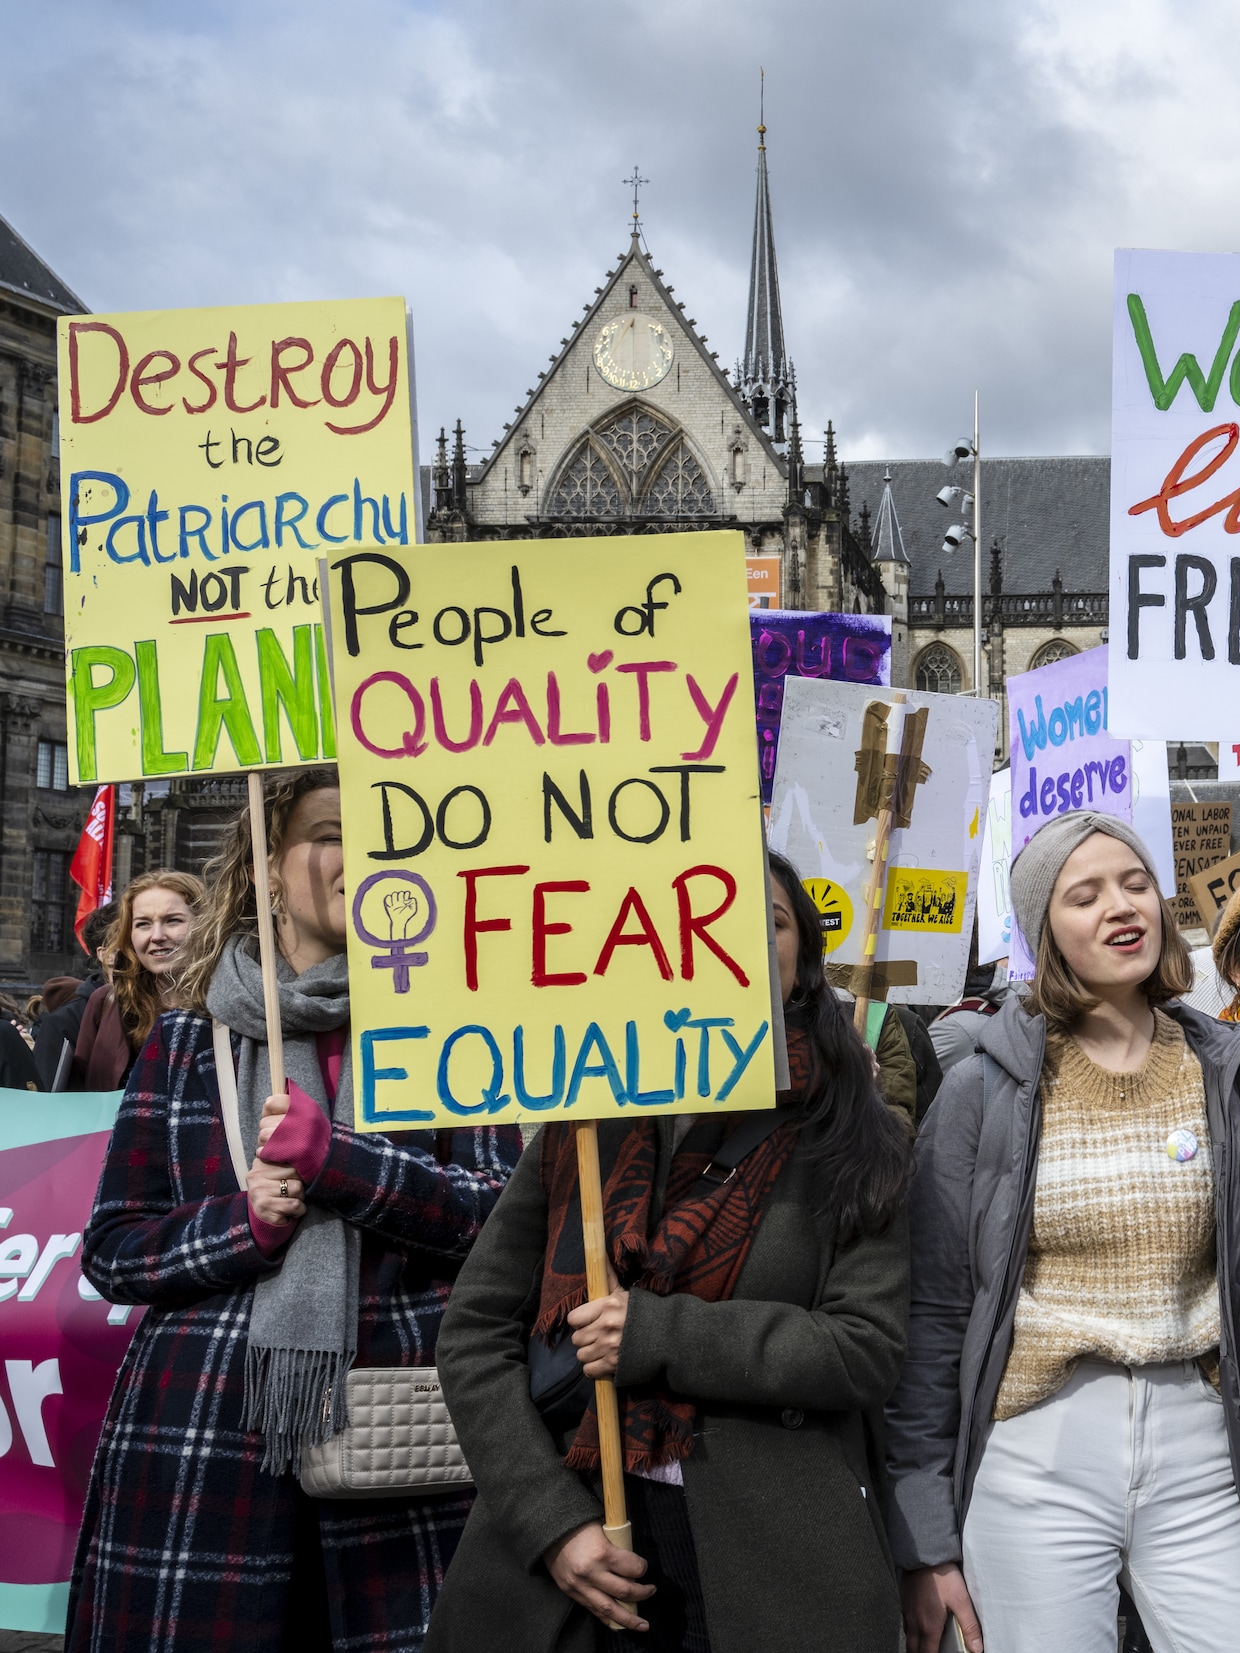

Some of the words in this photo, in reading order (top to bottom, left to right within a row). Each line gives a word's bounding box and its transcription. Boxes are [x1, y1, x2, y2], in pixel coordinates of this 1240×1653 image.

[198, 428, 284, 468] the
[170, 566, 250, 616] NOT
[330, 552, 568, 667] People
[613, 572, 683, 637] of
[751, 629, 881, 680] OUD
[70, 623, 338, 782] PLAN
[1019, 754, 1128, 818] deserve
[366, 781, 492, 862] DO
[542, 764, 727, 844] NOT
[1171, 810, 1197, 822] ONAL
[1202, 807, 1230, 821] LABOR
[1172, 826, 1190, 838] TEN
[1173, 840, 1197, 852] EVER
[1176, 883, 1191, 894] ER.
[457, 864, 751, 992] FEAR
[820, 917, 840, 927] TEST
[891, 912, 925, 924] TOGETHER
[928, 914, 938, 924] WE
[939, 915, 954, 925] RISE
[0, 1232, 82, 1303] er
